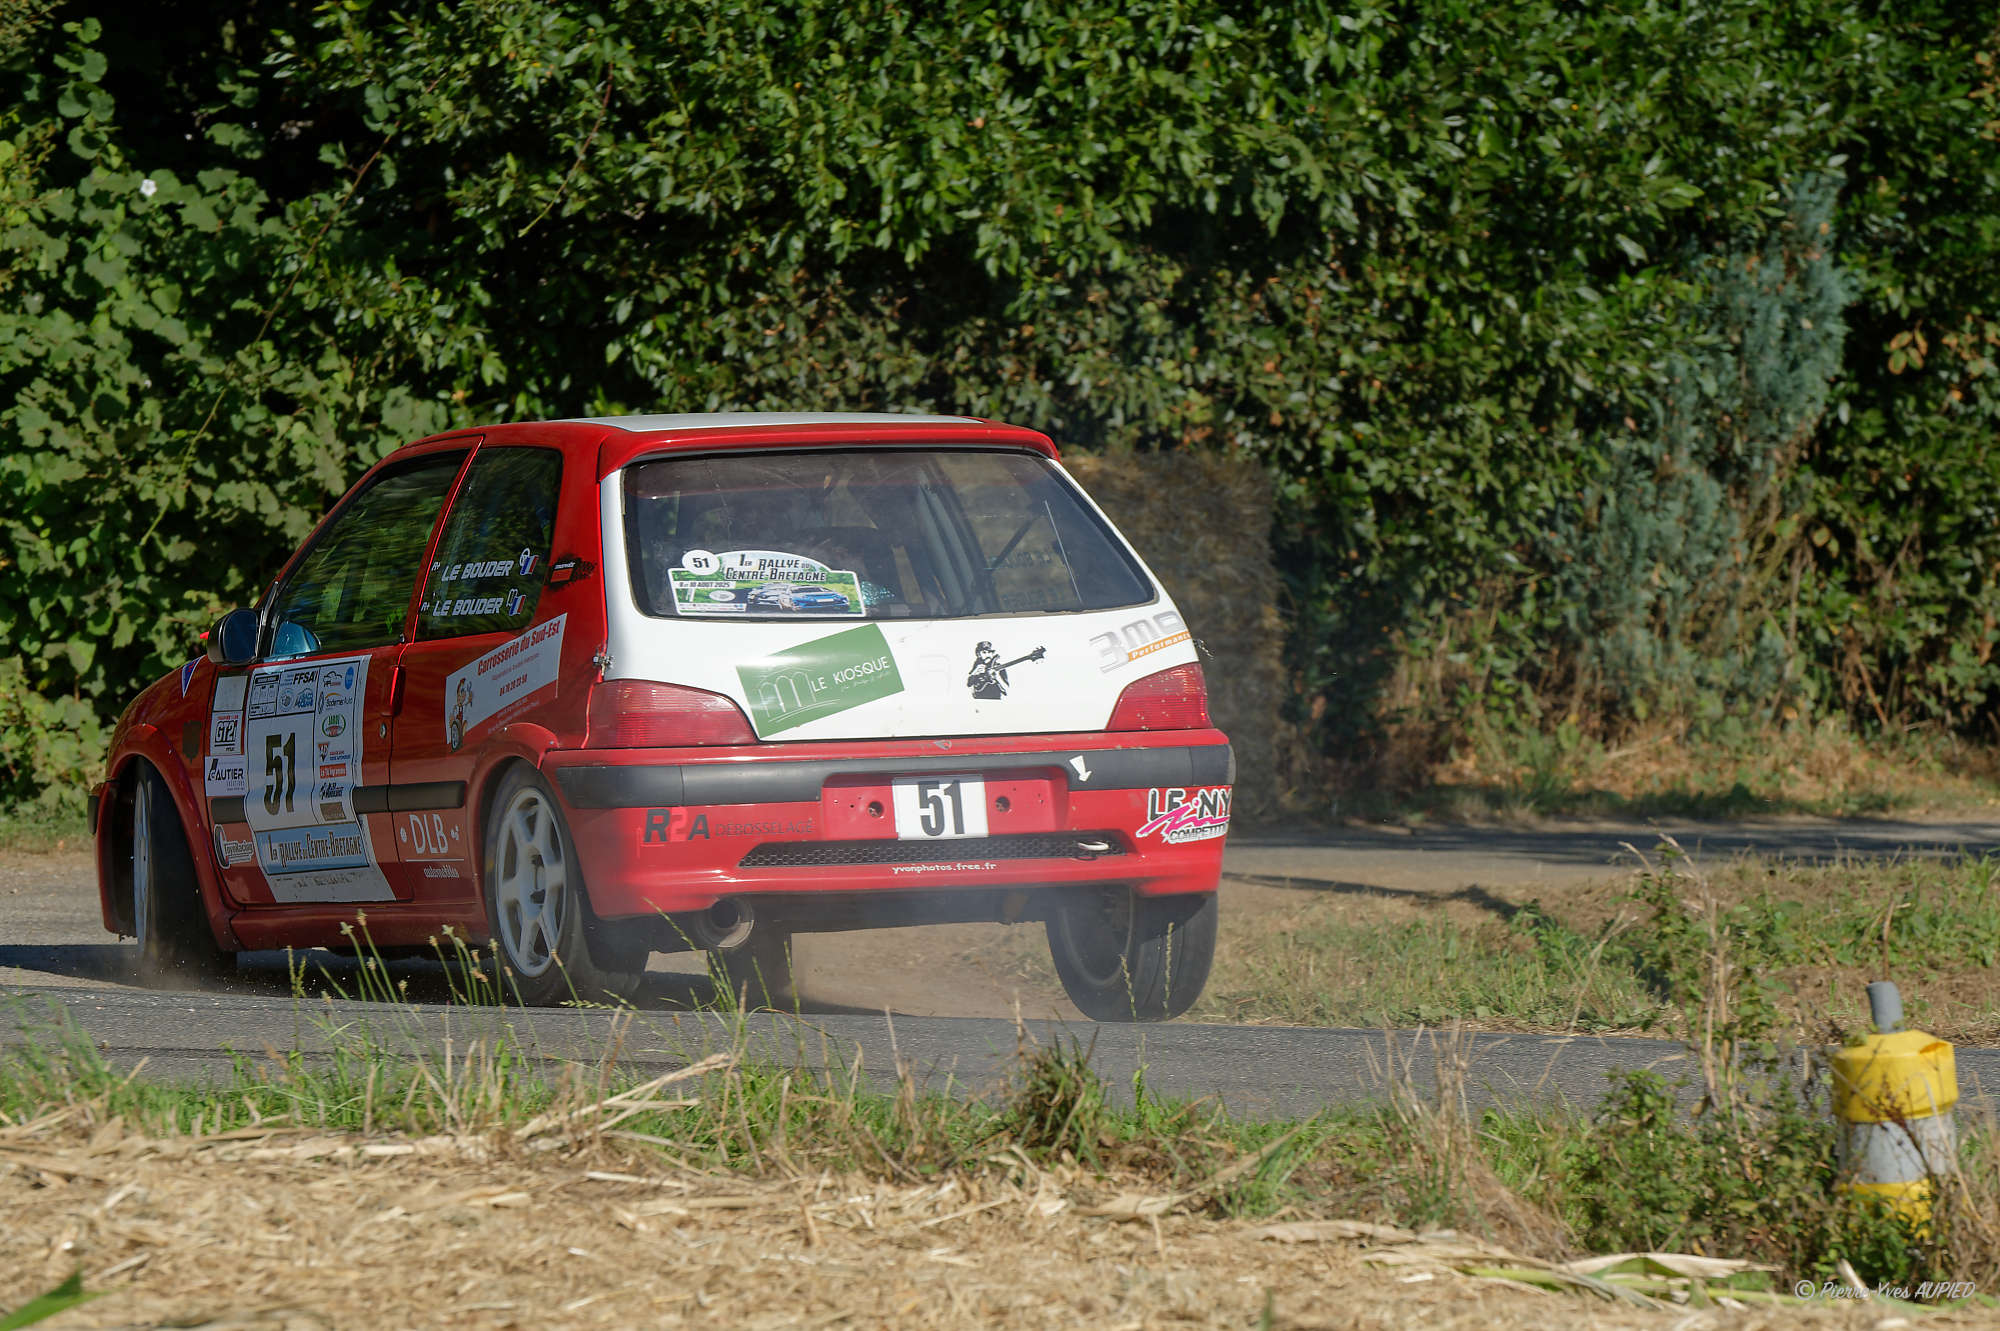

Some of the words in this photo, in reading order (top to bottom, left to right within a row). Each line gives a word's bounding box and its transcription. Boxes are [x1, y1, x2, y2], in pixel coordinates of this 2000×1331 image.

[441, 563, 462, 582] LE
[461, 560, 514, 579] BOUDER
[692, 557, 710, 569] 51
[725, 568, 827, 581] CENTRE-BRETAGNE
[758, 558, 800, 571] RALLYE
[433, 600, 453, 617] LE
[452, 597, 504, 615] BOUDER
[477, 640, 520, 676] Carrosserie
[520, 635, 531, 653] du
[530, 620, 561, 647] Sud-Est
[292, 671, 315, 685] FFSA
[811, 676, 828, 693] LE
[832, 656, 891, 685] KIOSQUE
[264, 732, 296, 816] 51
[918, 780, 965, 836] 51
[408, 814, 449, 854] DLB
[279, 840, 302, 868] RALLYE
[307, 831, 363, 860] CENTRE-BRETAGNE
